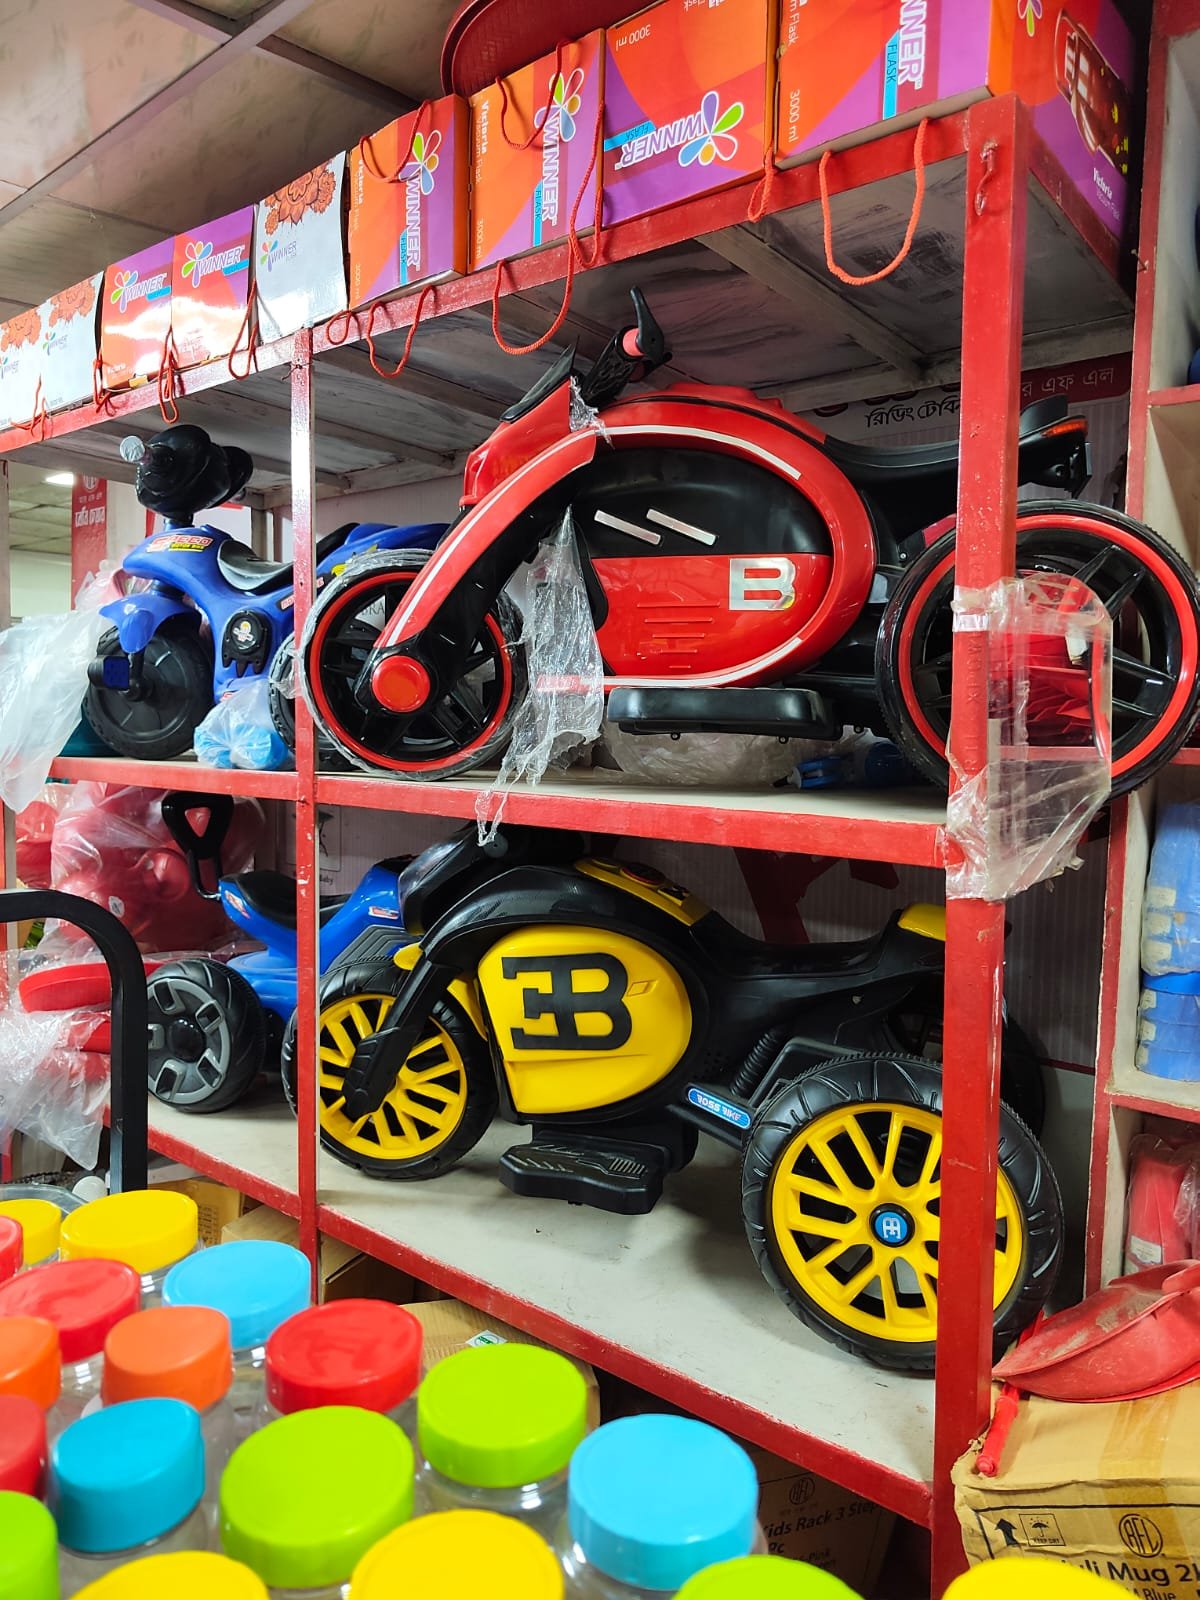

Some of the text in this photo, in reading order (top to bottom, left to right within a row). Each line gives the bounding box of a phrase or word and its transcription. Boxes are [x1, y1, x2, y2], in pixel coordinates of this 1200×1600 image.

[616, 24, 651, 51] 3000 ml
[788, 13, 799, 45] Flask
[898, 0, 927, 86] NNER
[887, 43, 897, 83] FLASK
[788, 89, 800, 143] 3000 ml
[621, 111, 703, 167] WINNER
[624, 125, 649, 141] FLASK
[542, 117, 560, 222] WINNER
[406, 178, 421, 268] WINNER
[199, 247, 241, 278] WINNER
[271, 241, 297, 264] WINNER
[126, 273, 164, 302] WINNER
[1042, 373, 1075, 393] এফ
[1083, 368, 1114, 385] এল
[865, 404, 915, 428] রিডিং
[917, 396, 960, 419] টেবি
[796, 1510, 831, 1531] Rack
[835, 1507, 844, 1520] 3
[1121, 1515, 1160, 1556] RFL
[1107, 1561, 1170, 1587] Mug
